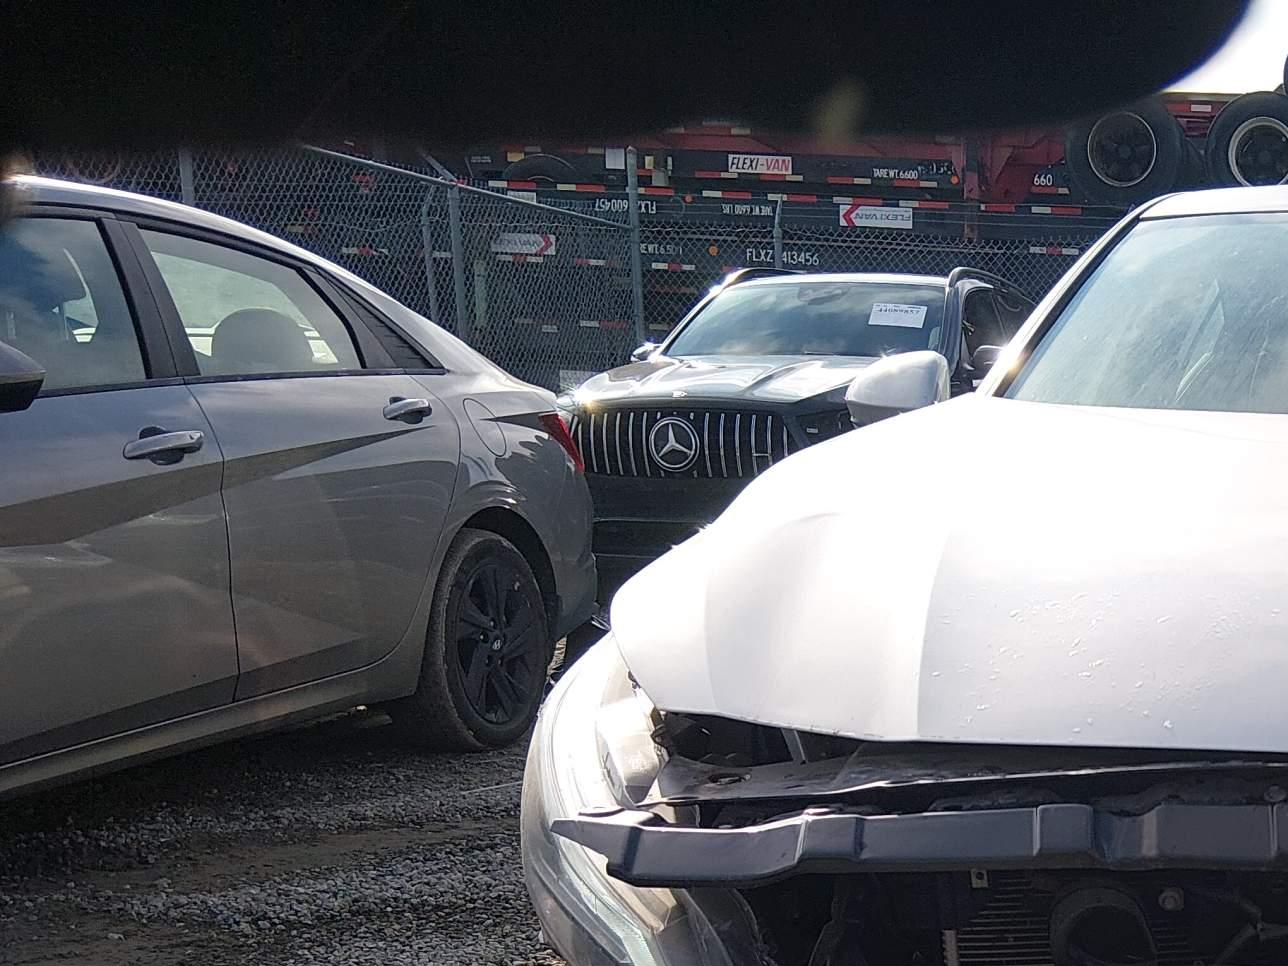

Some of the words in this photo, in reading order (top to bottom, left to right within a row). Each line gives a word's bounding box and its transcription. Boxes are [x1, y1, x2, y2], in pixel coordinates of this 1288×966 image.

[730, 155, 790, 172] FLEXI-VAN
[873, 168, 888, 178] TARE
[854, 212, 879, 220] VAN
[882, 213, 912, 222] FLEXI
[746, 249, 774, 263] FLXZ
[781, 251, 819, 266] 413456
